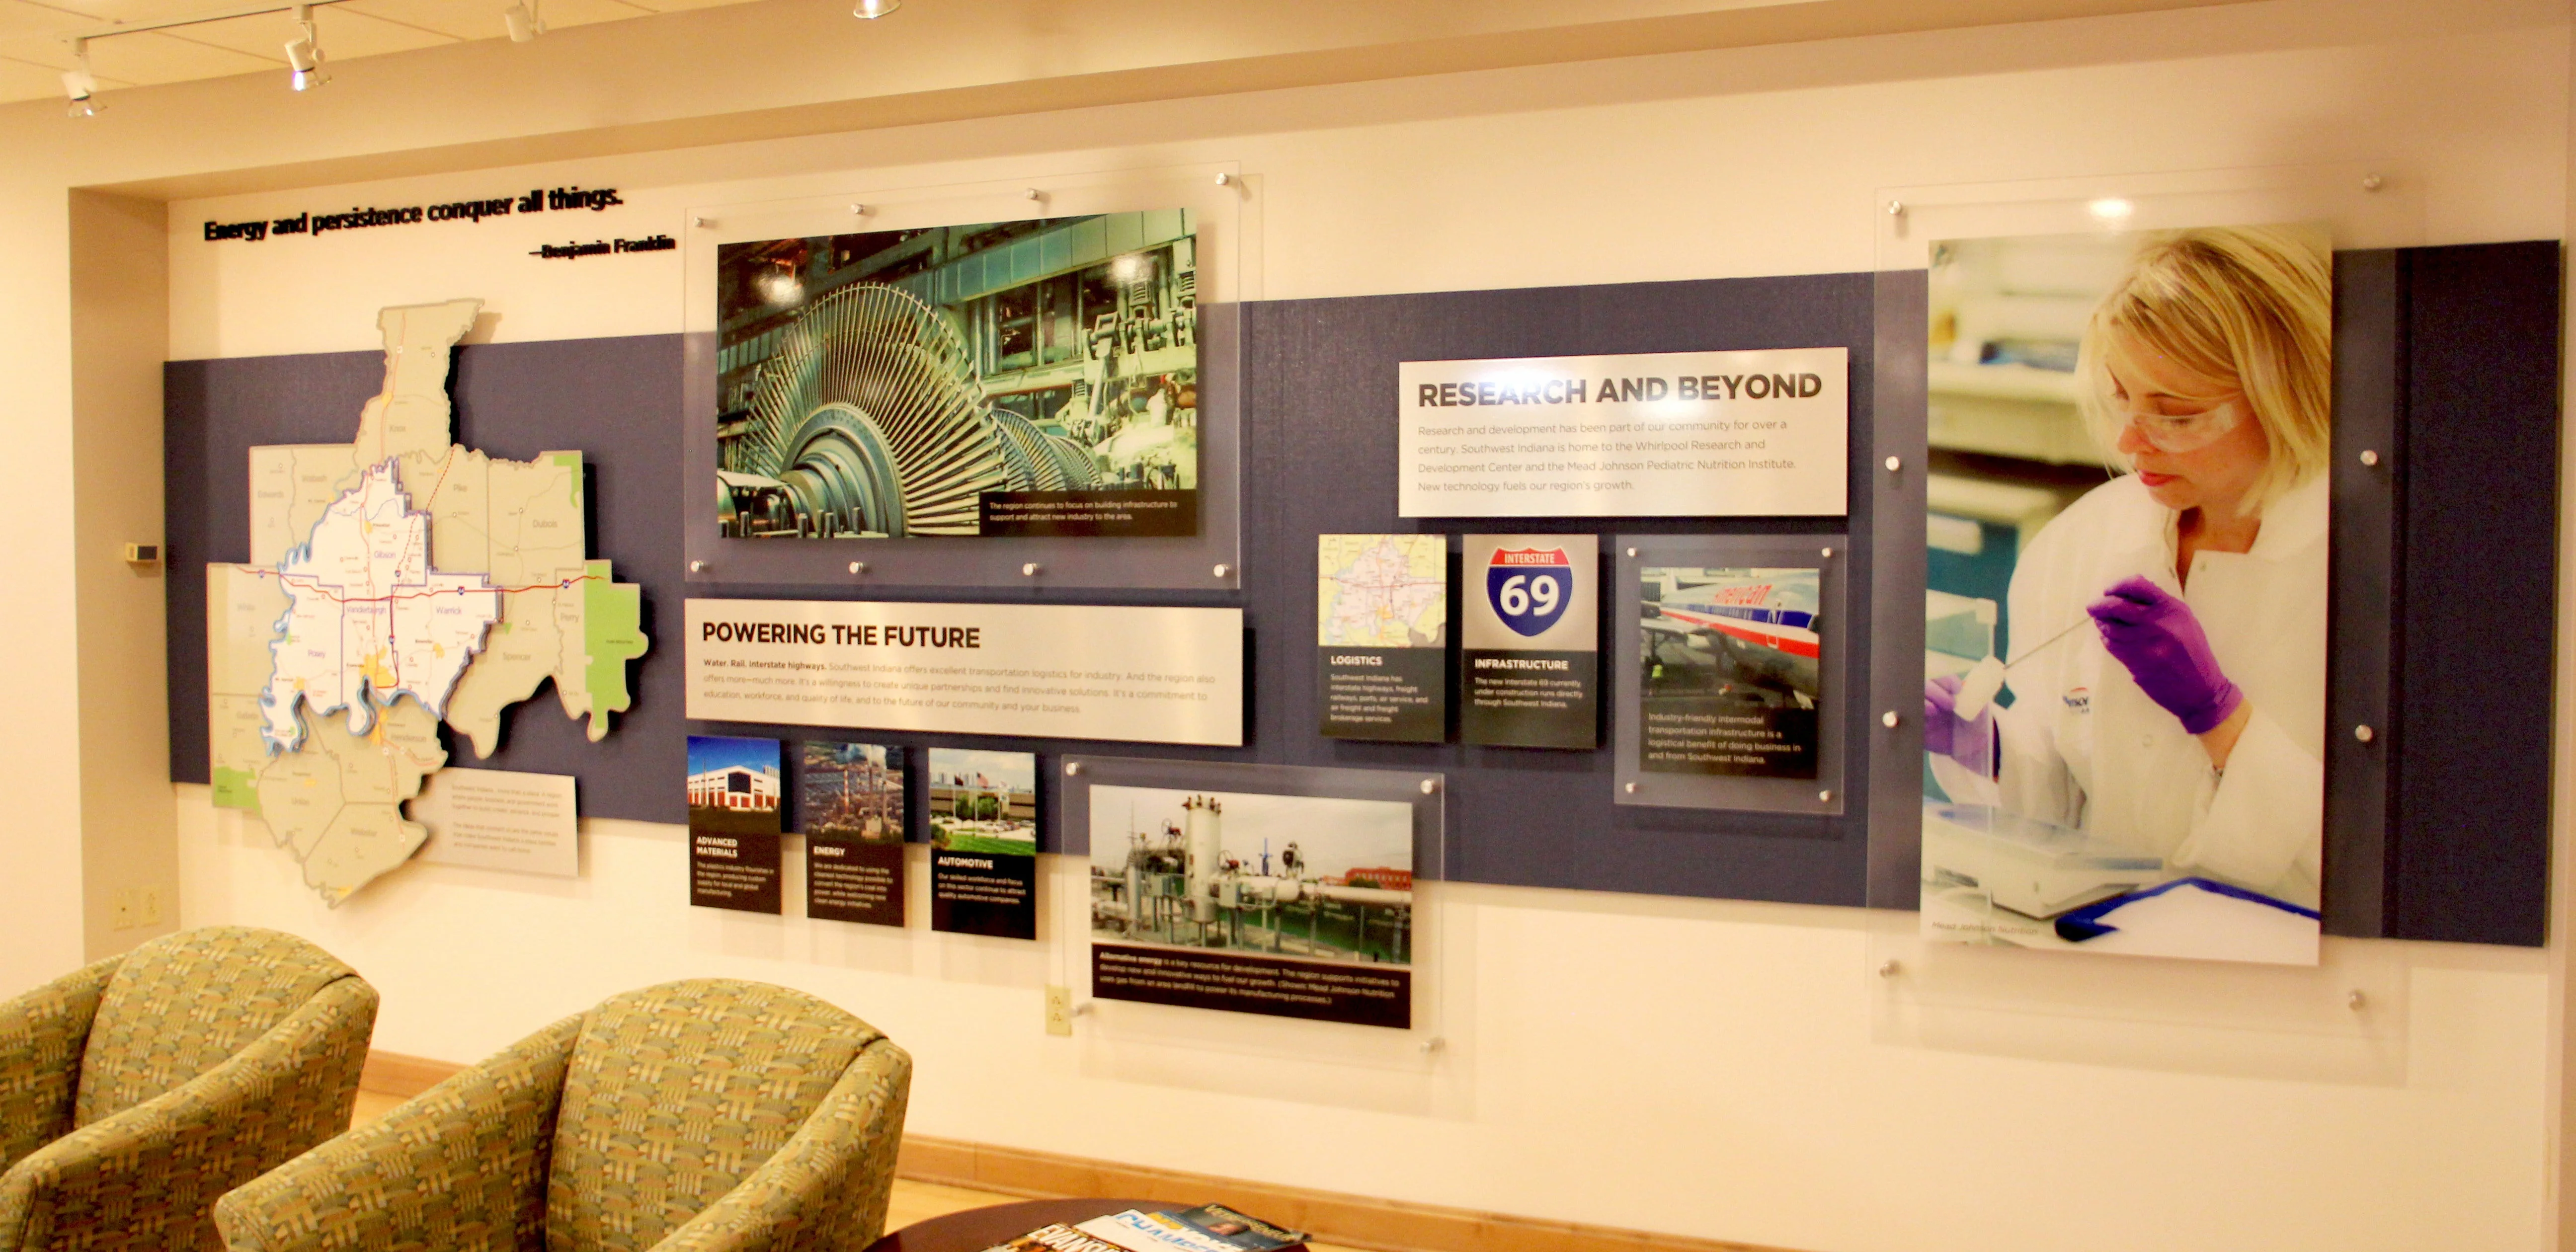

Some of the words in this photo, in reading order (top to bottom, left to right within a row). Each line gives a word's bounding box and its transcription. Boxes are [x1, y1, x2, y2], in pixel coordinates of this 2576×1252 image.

[205, 220, 268, 242] Energy
[272, 212, 308, 235] and
[313, 205, 422, 237] persistence
[427, 194, 513, 224] conquer
[518, 189, 543, 213] all
[549, 186, 624, 211] things.
[529, 238, 611, 260] —Benjamin
[614, 234, 675, 254] Franklin
[1419, 380, 1586, 406] RESEARCH
[1596, 377, 1667, 402] AND
[1679, 373, 1822, 399] BEYOND
[1418, 426, 1465, 436] Research
[1466, 425, 1486, 435] and
[1489, 425, 1556, 435] development
[1559, 424, 1577, 433] has
[1580, 424, 1607, 433] been
[1609, 423, 1632, 434] part
[1633, 422, 1645, 435] of
[1648, 424, 1665, 434] our
[1669, 421, 1732, 434] community
[1734, 419, 1749, 430] for
[1752, 421, 1777, 430] over
[1780, 421, 1787, 430] a
[1418, 446, 1457, 456] century.
[1461, 444, 1515, 454] Southwest
[1518, 443, 1555, 453] Indiana
[1558, 443, 1566, 453] is
[1568, 443, 1598, 452] home
[1601, 443, 1613, 452] to
[1615, 442, 1633, 452] the
[1636, 441, 1689, 452] Whirlpool
[1691, 440, 1742, 451] Research
[1745, 440, 1766, 450] and
[1418, 464, 1485, 473] Development
[1488, 463, 1522, 472] Center
[1526, 462, 1546, 472] and
[1547, 461, 1565, 472] the
[1567, 462, 1596, 471] Mead
[1600, 461, 1644, 471] Johnson
[1647, 460, 1693, 470] Pediatric
[1697, 460, 1746, 470] Nutrition
[1749, 459, 1795, 469] Institute.
[1418, 482, 1441, 491] New
[1444, 482, 1500, 493] technology
[1503, 481, 1527, 491] fuels
[1550, 481, 1590, 492] region's
[1594, 480, 1634, 491] growth.
[1505, 553, 1554, 564] INTERSTATE
[1500, 574, 1559, 617] 69
[703, 623, 825, 643] POWERING
[832, 625, 877, 645] THE
[885, 626, 979, 648] FUTURE
[1330, 655, 1383, 666] LOGISTICS
[1474, 658, 1569, 671] INFRASTRUCTURE
[703, 659, 728, 667] Water.
[730, 659, 747, 668] Rail.
[749, 661, 786, 669] Interstate
[787, 661, 827, 671] highways.
[829, 662, 870, 671] Southwest
[873, 664, 902, 672] Indiana
[904, 664, 928, 674] offers
[929, 666, 966, 675] excellent
[969, 668, 1030, 677] transportation
[1032, 670, 1067, 678] logistics
[1085, 672, 1121, 681] industry.
[1126, 672, 1145, 681] And
[1649, 713, 1717, 724] Industry-friendly
[1718, 715, 1765, 725] intermodal
[1649, 727, 1708, 736] transportation
[1709, 728, 1766, 738] infrastructure
[1766, 730, 1774, 739] is
[1648, 738, 1685, 748] logistical
[1685, 740, 1716, 749] benefit
[1718, 741, 1727, 749] of
[1727, 741, 1754, 752] doing
[1754, 742, 1791, 752] business
[1648, 752, 1664, 761] and
[1666, 752, 1686, 761] from
[1687, 753, 1732, 763] Southwest
[1734, 755, 1765, 764] Indiana.
[697, 836, 737, 847] ADVANCED
[697, 846, 737, 858] MATERIALS
[813, 846, 845, 857] ENERGY
[938, 856, 993, 869] AUTOMOTIVE
